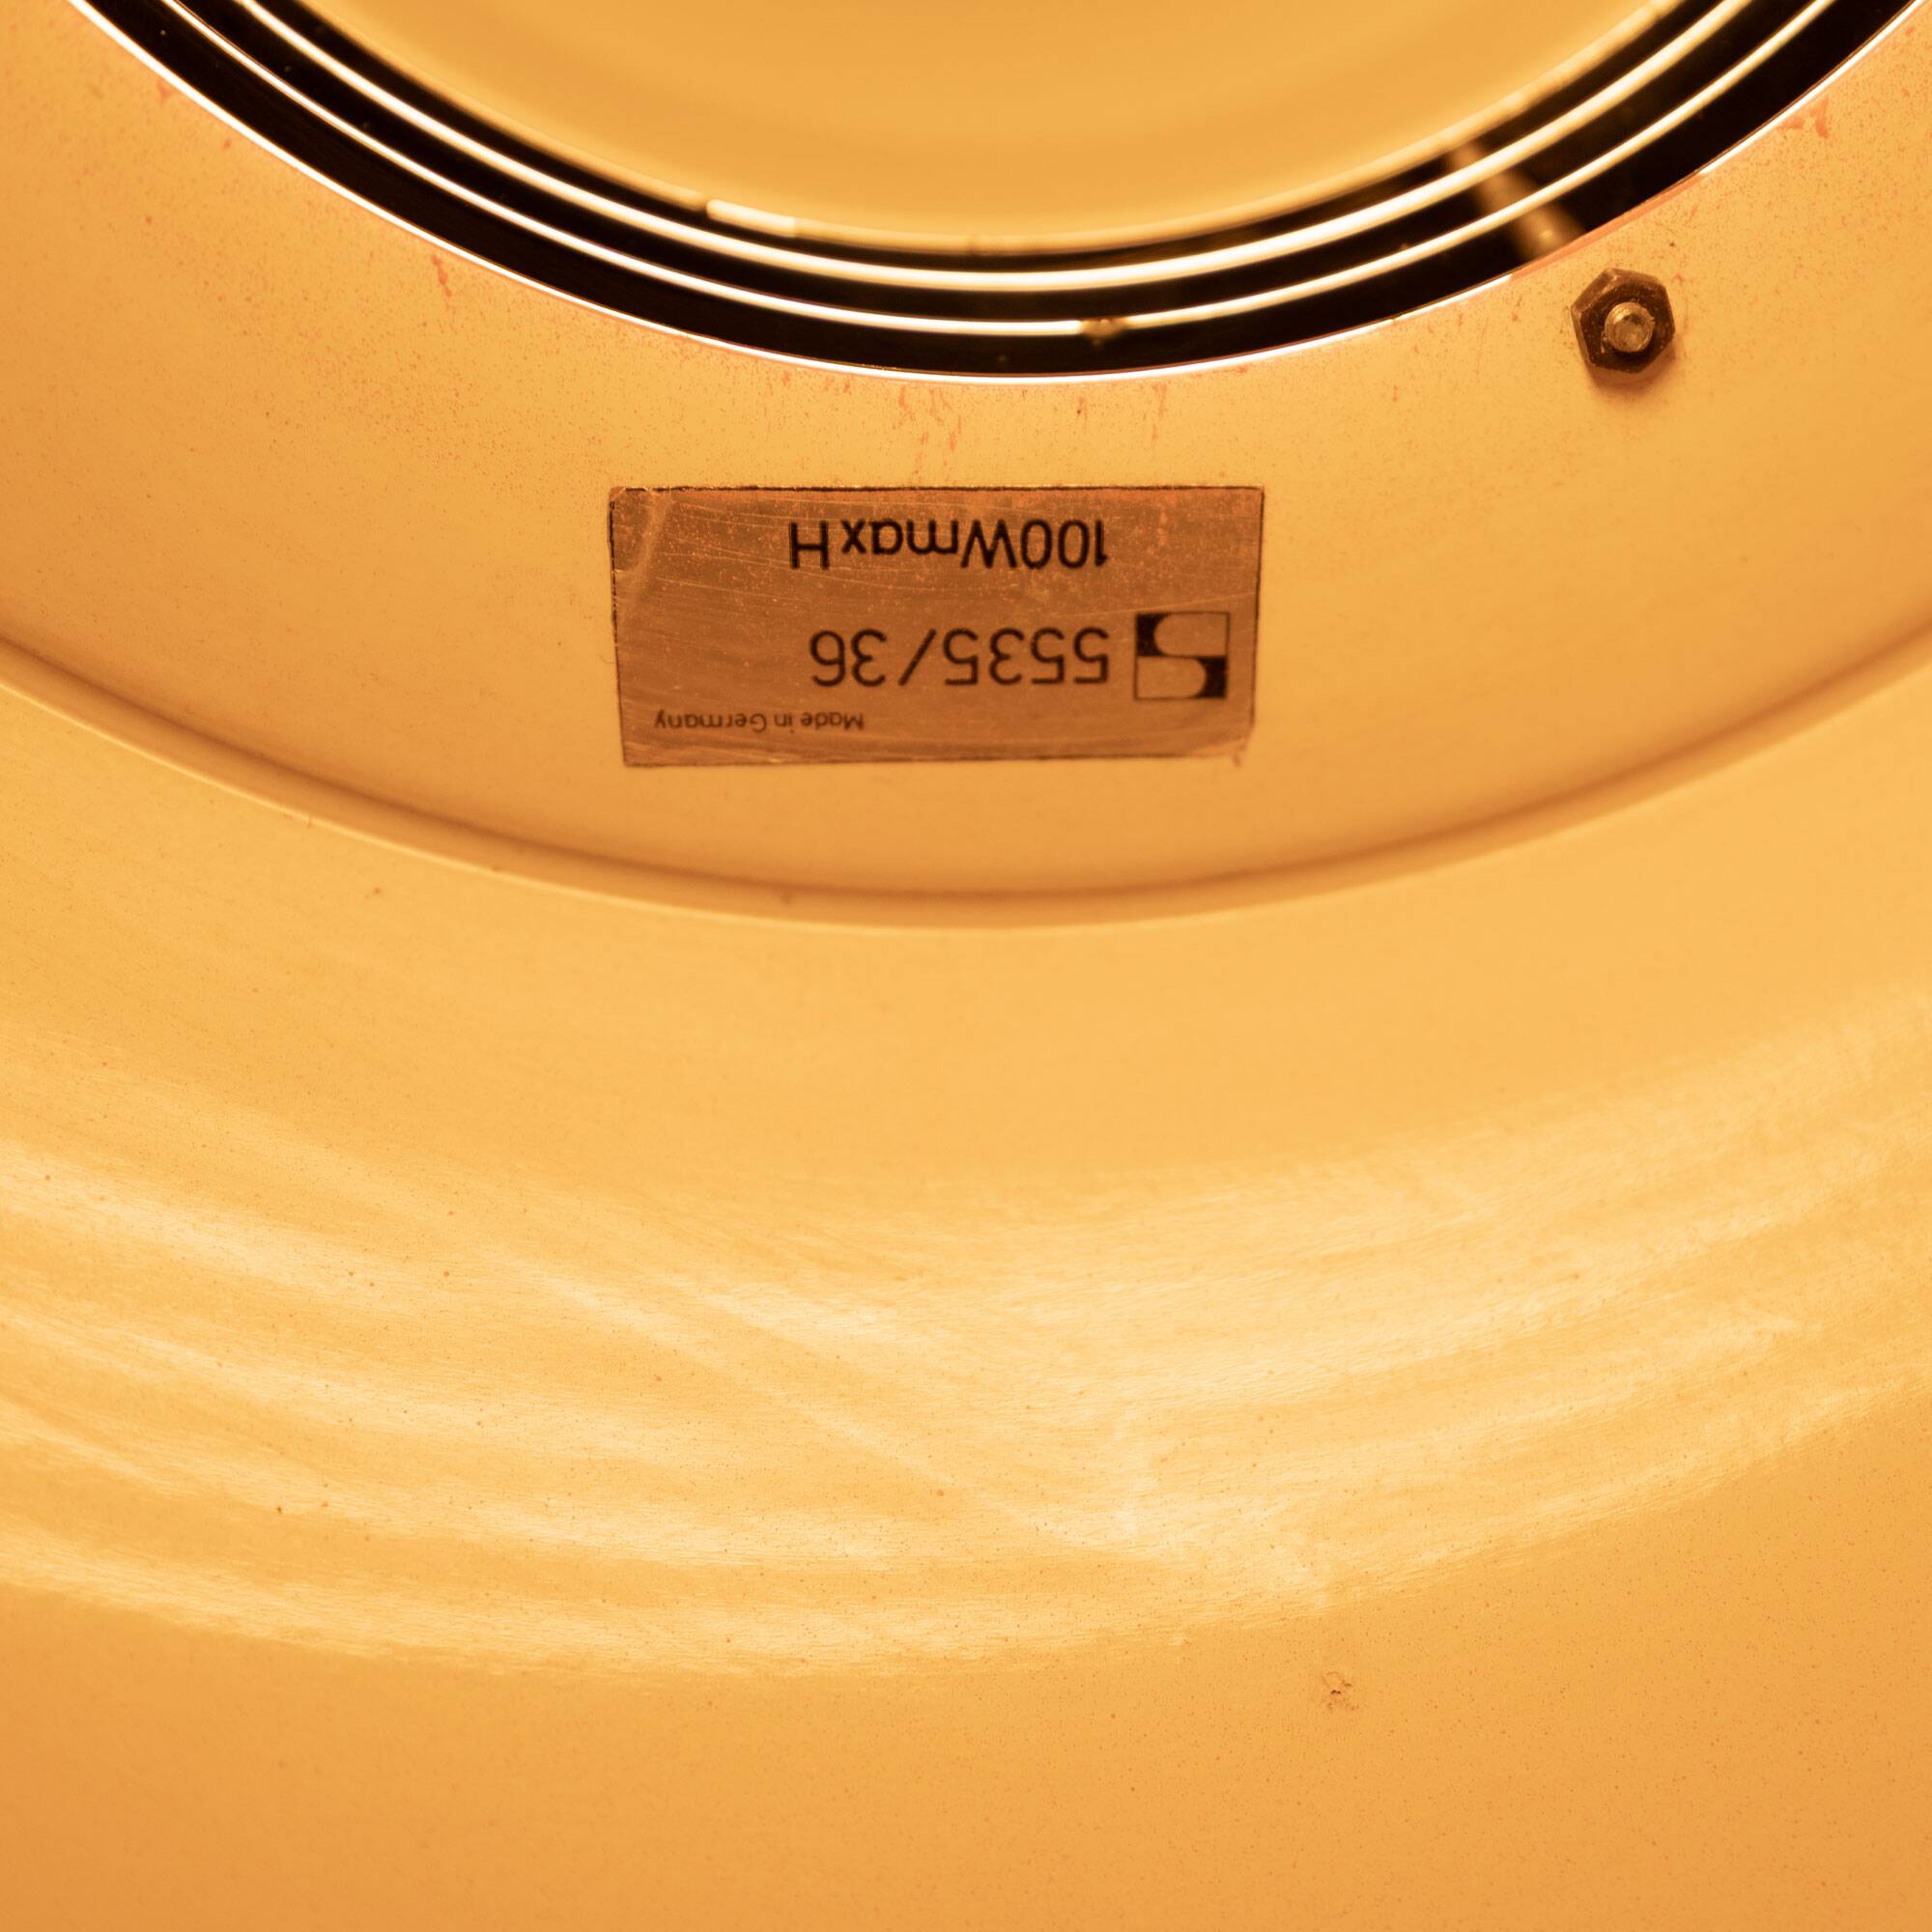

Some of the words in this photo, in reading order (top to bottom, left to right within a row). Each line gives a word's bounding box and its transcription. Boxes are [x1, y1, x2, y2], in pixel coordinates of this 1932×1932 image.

[809, 628, 1109, 687] 5535/36
[654, 710, 768, 732] Germany
[774, 714, 794, 732] in
[801, 711, 864, 732] Made
